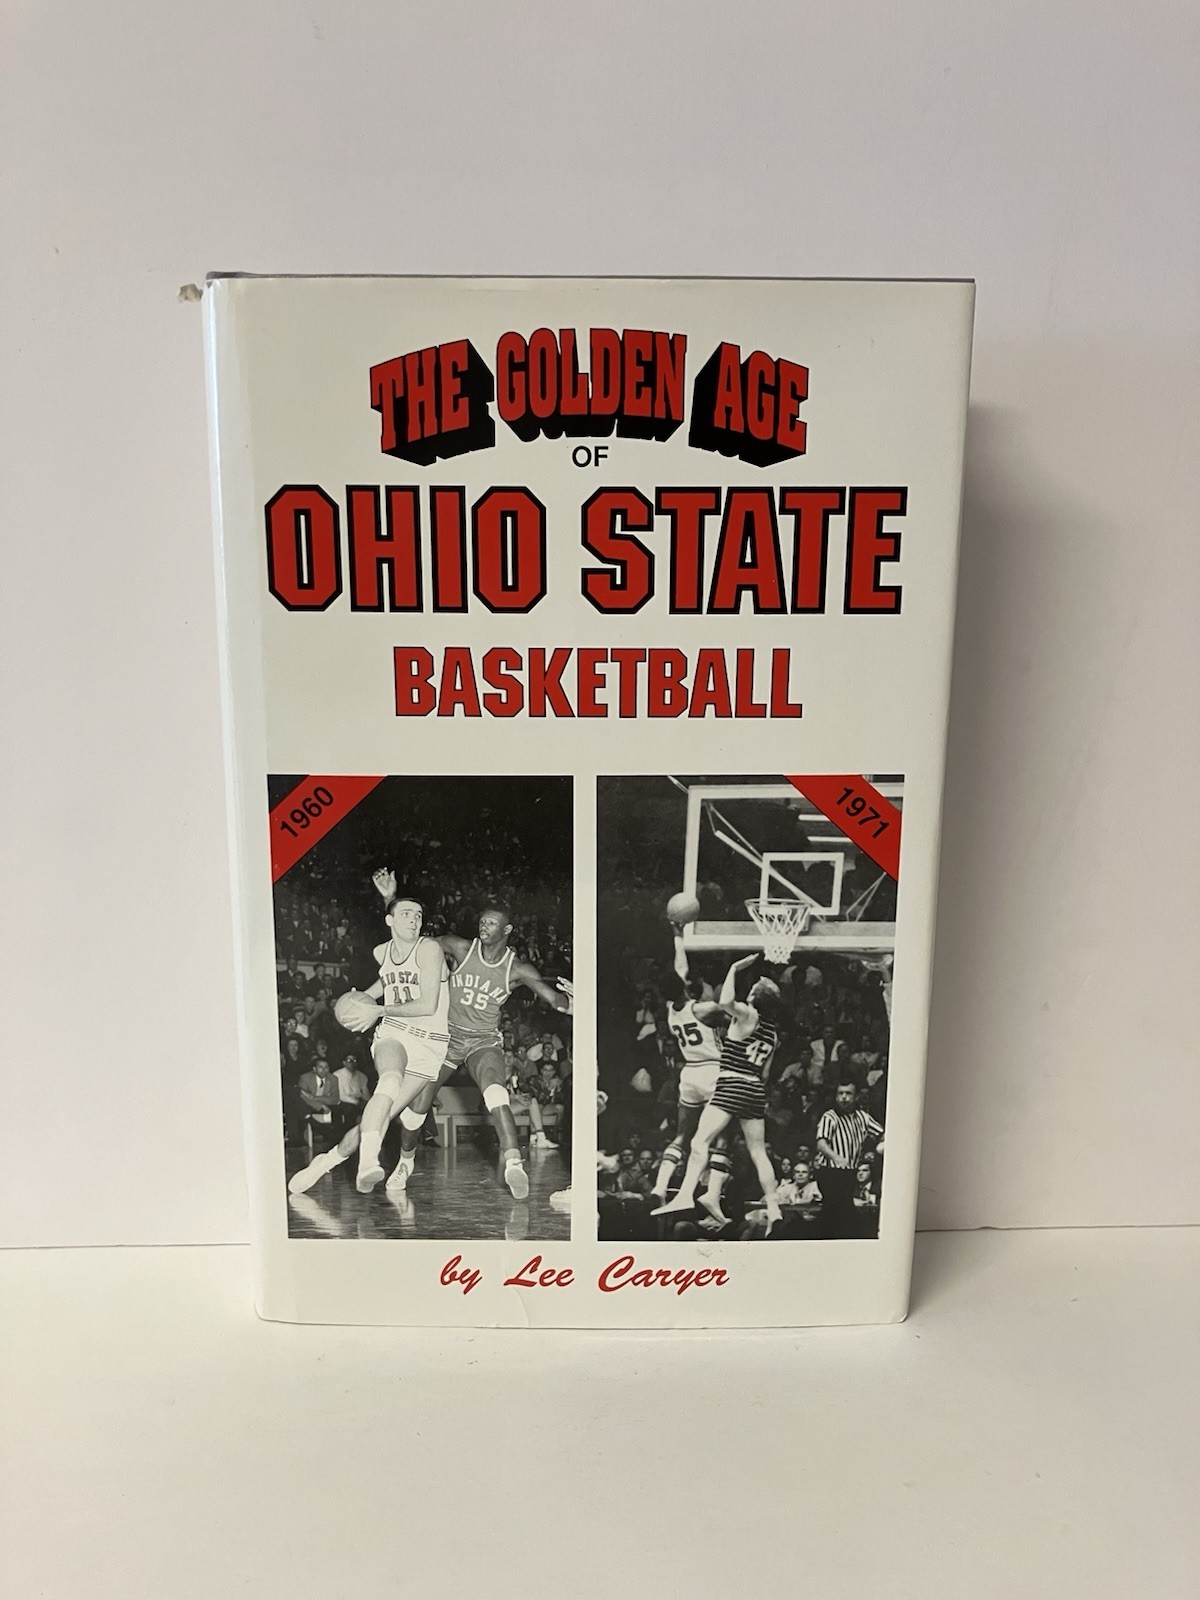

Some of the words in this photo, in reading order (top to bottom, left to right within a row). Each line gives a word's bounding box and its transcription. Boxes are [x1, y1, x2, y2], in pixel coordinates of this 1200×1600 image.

[369, 338, 495, 466] THE
[495, 327, 688, 443] GOLDEN
[688, 341, 810, 468] AGE
[571, 446, 610, 468] OF
[265, 484, 547, 614] OHIO
[581, 486, 908, 615] STATE
[393, 646, 803, 719] BASKETBALL
[280, 786, 334, 838] 1960
[834, 787, 889, 839] 1971
[399, 971, 419, 986] STA
[460, 988, 490, 1011] 35
[745, 1040, 774, 1067] 42
[440, 1255, 482, 1295] by
[503, 1255, 575, 1287] Lee
[598, 1255, 730, 1295] Caryer
